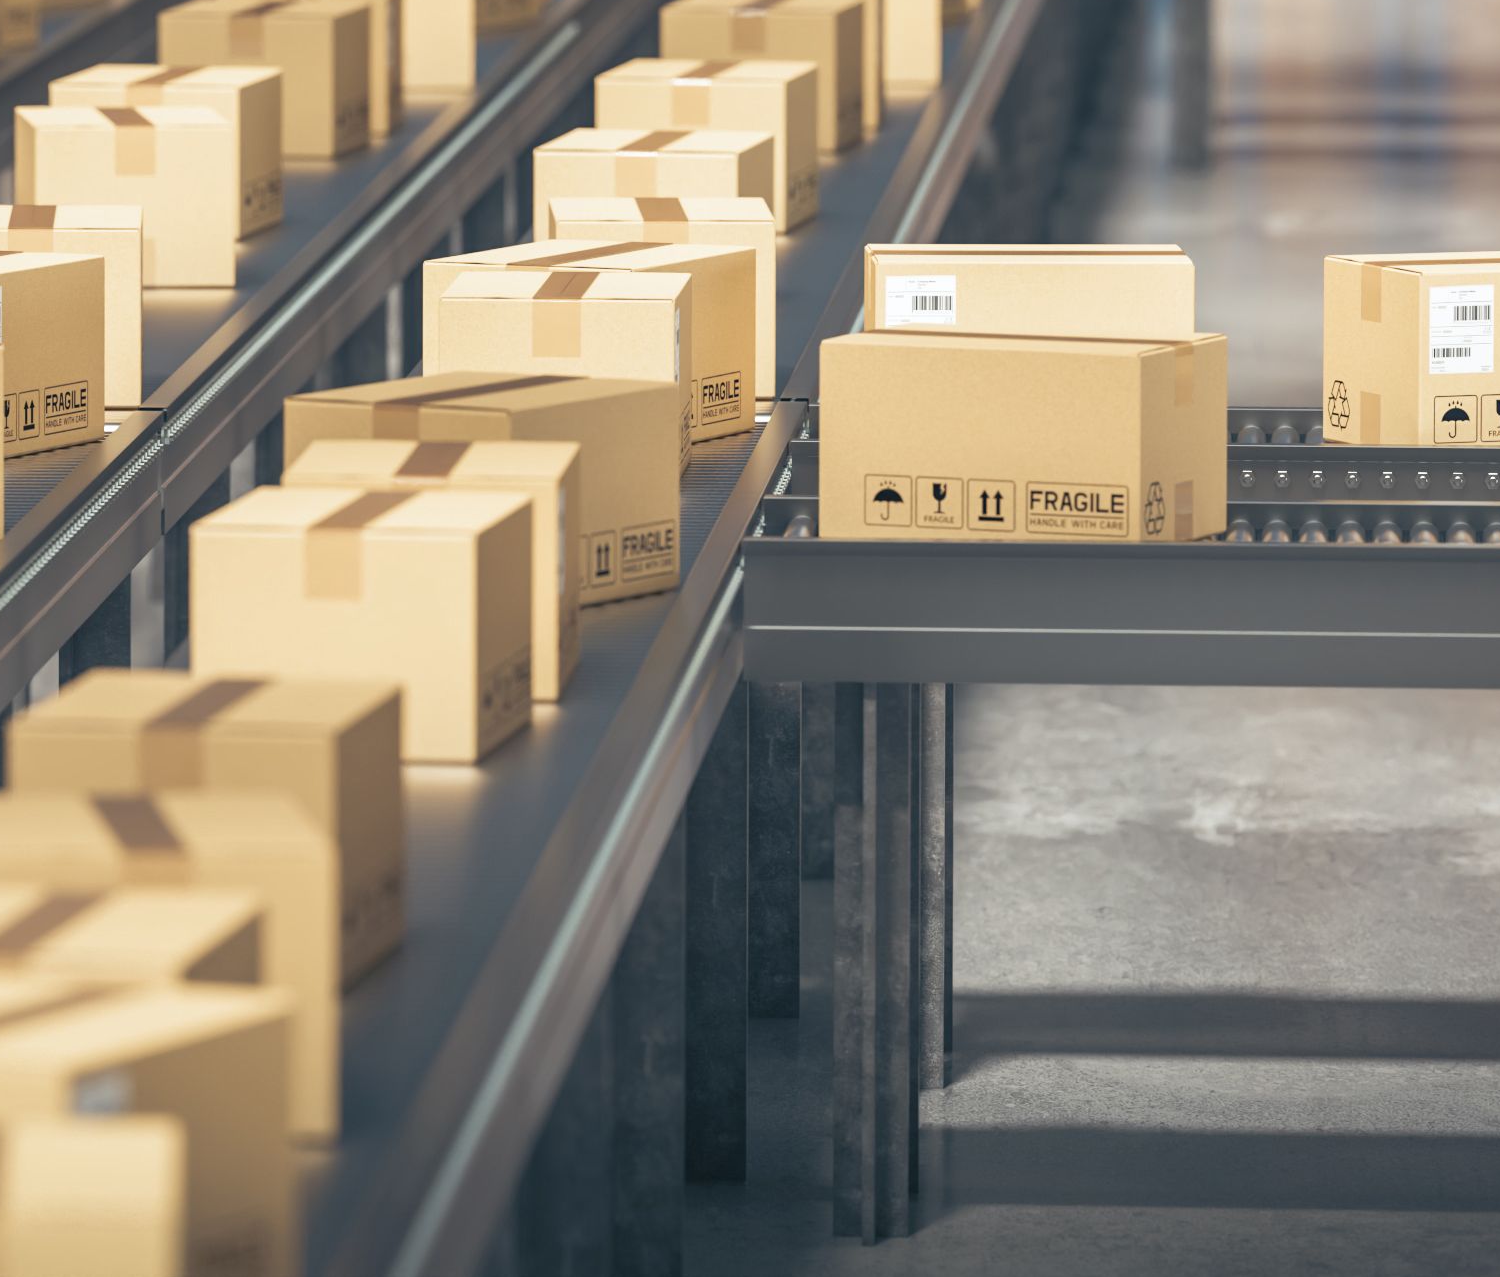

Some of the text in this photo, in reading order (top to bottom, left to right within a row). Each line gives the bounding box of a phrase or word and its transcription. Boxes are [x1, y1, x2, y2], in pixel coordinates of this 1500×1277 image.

[45, 388, 86, 414] FRAGILE
[702, 379, 739, 403] FRAGILE
[45, 414, 86, 428] HANDLE WITH CARE
[1030, 490, 1125, 514] FRAGILE
[923, 515, 955, 524] FRAGILE
[1029, 518, 1124, 530] HANDLE WITH CARE
[622, 529, 673, 557] FRAGILE
